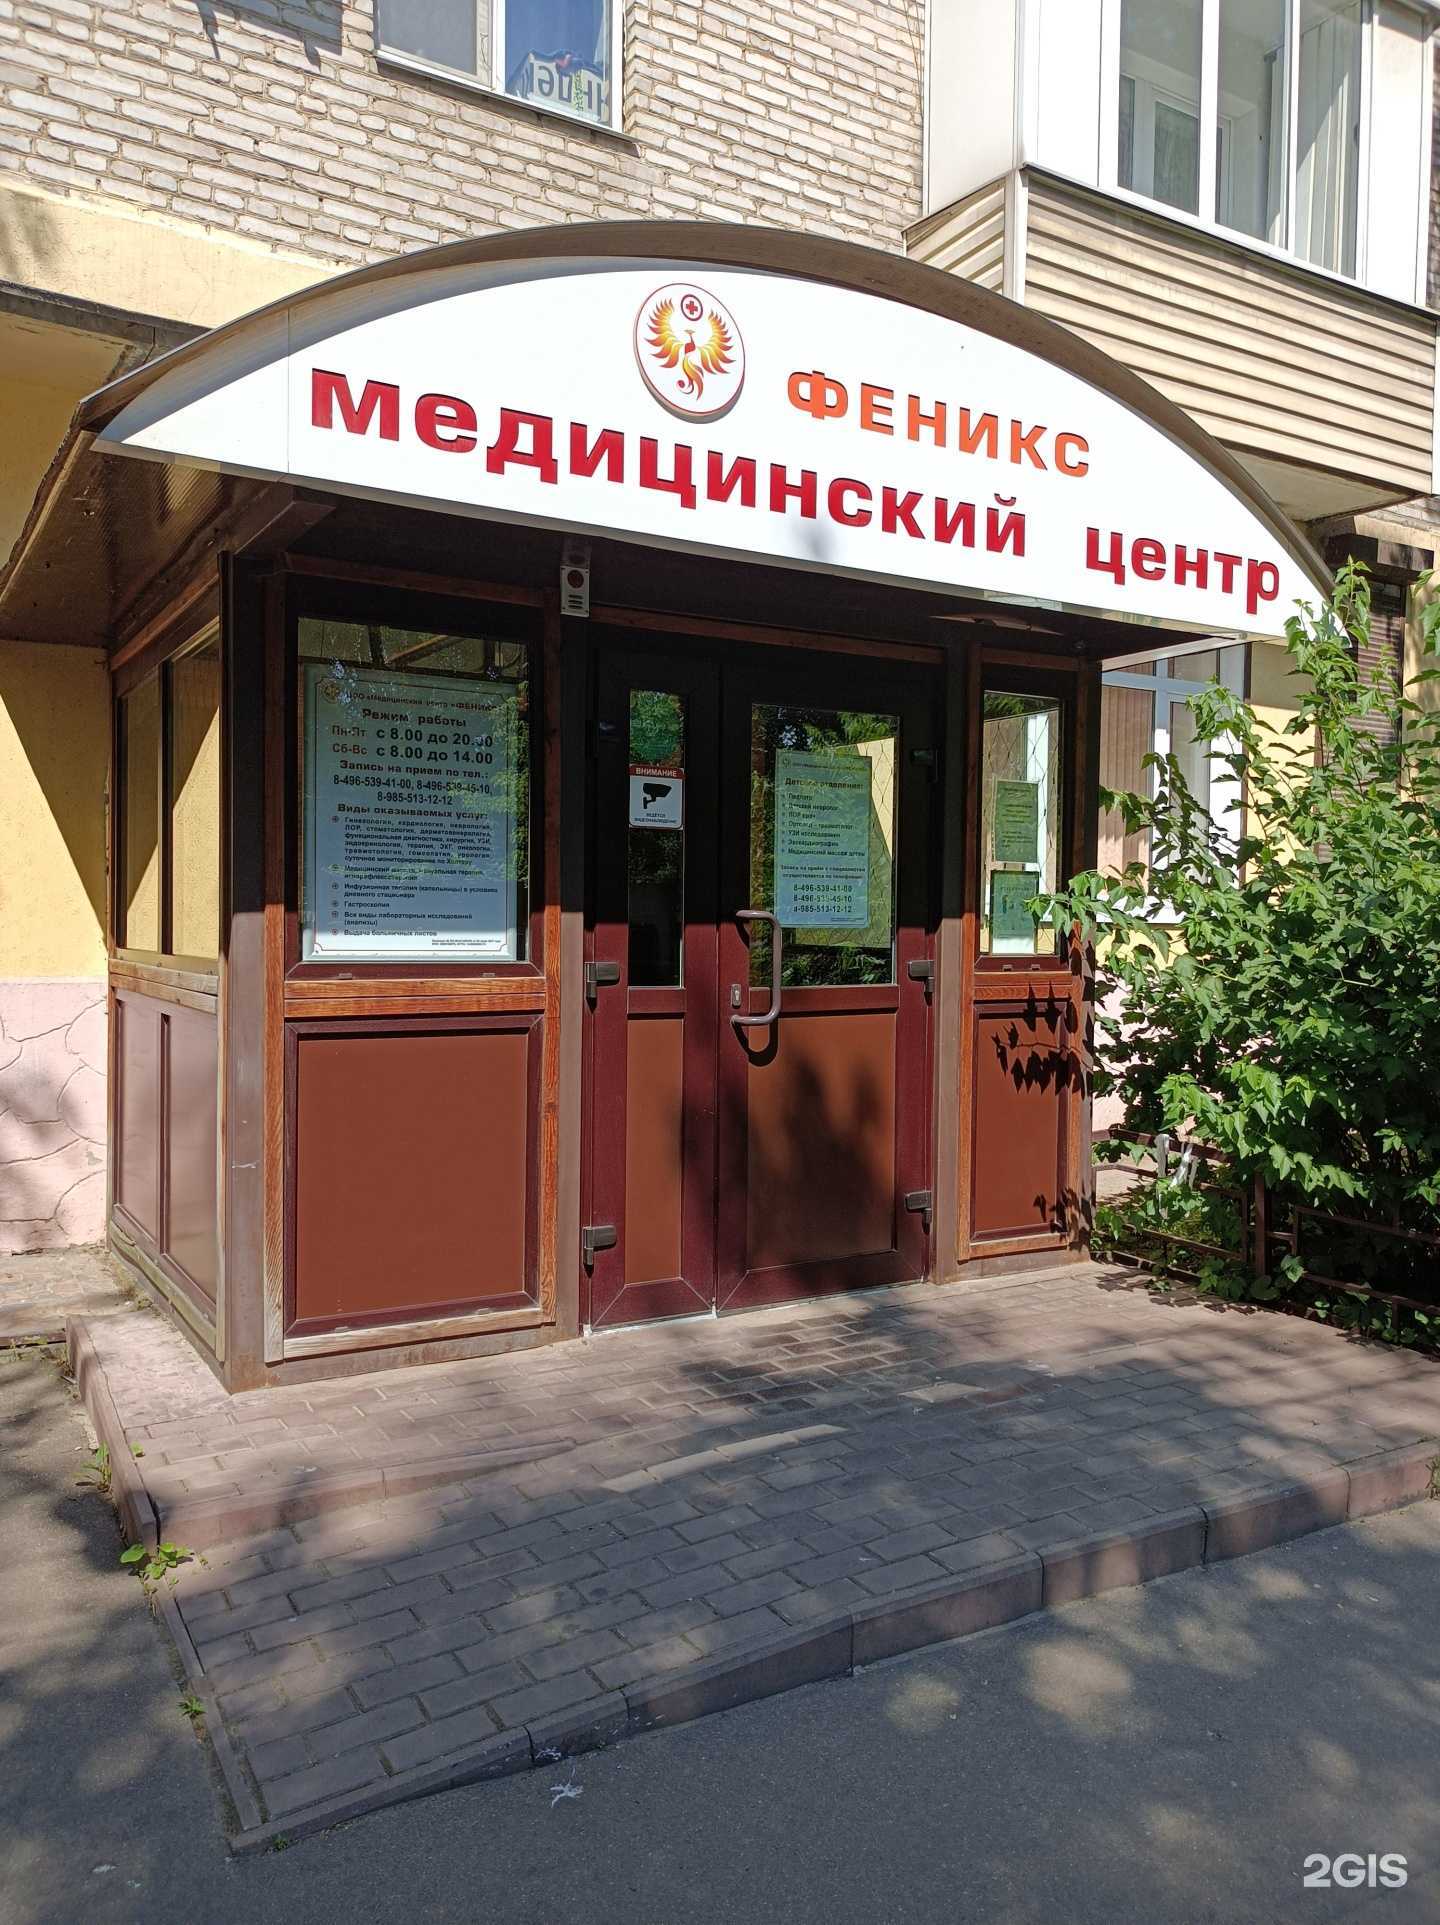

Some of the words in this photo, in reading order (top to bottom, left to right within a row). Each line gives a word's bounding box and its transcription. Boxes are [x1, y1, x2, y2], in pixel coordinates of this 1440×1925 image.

[787, 369, 1091, 479] ФЕНИКС
[1086, 526, 1280, 615] центр
[362, 708, 409, 721] Режим
[418, 714, 466, 727] работы
[332, 725, 367, 737] Пн-Пт
[390, 727, 423, 742] 8.00
[427, 733, 448, 744] до
[333, 743, 368, 755] Сб-Вс
[390, 745, 423, 759] 8.00
[427, 751, 448, 762] до
[453, 751, 493, 764] 14.00
[340, 760, 384, 771] Запись
[446, 769, 459, 777] по
[636, 767, 678, 777] ВНИМАНИЕ
[377, 791, 453, 805] 8-985-513-12-12
[338, 803, 370, 813] Виды
